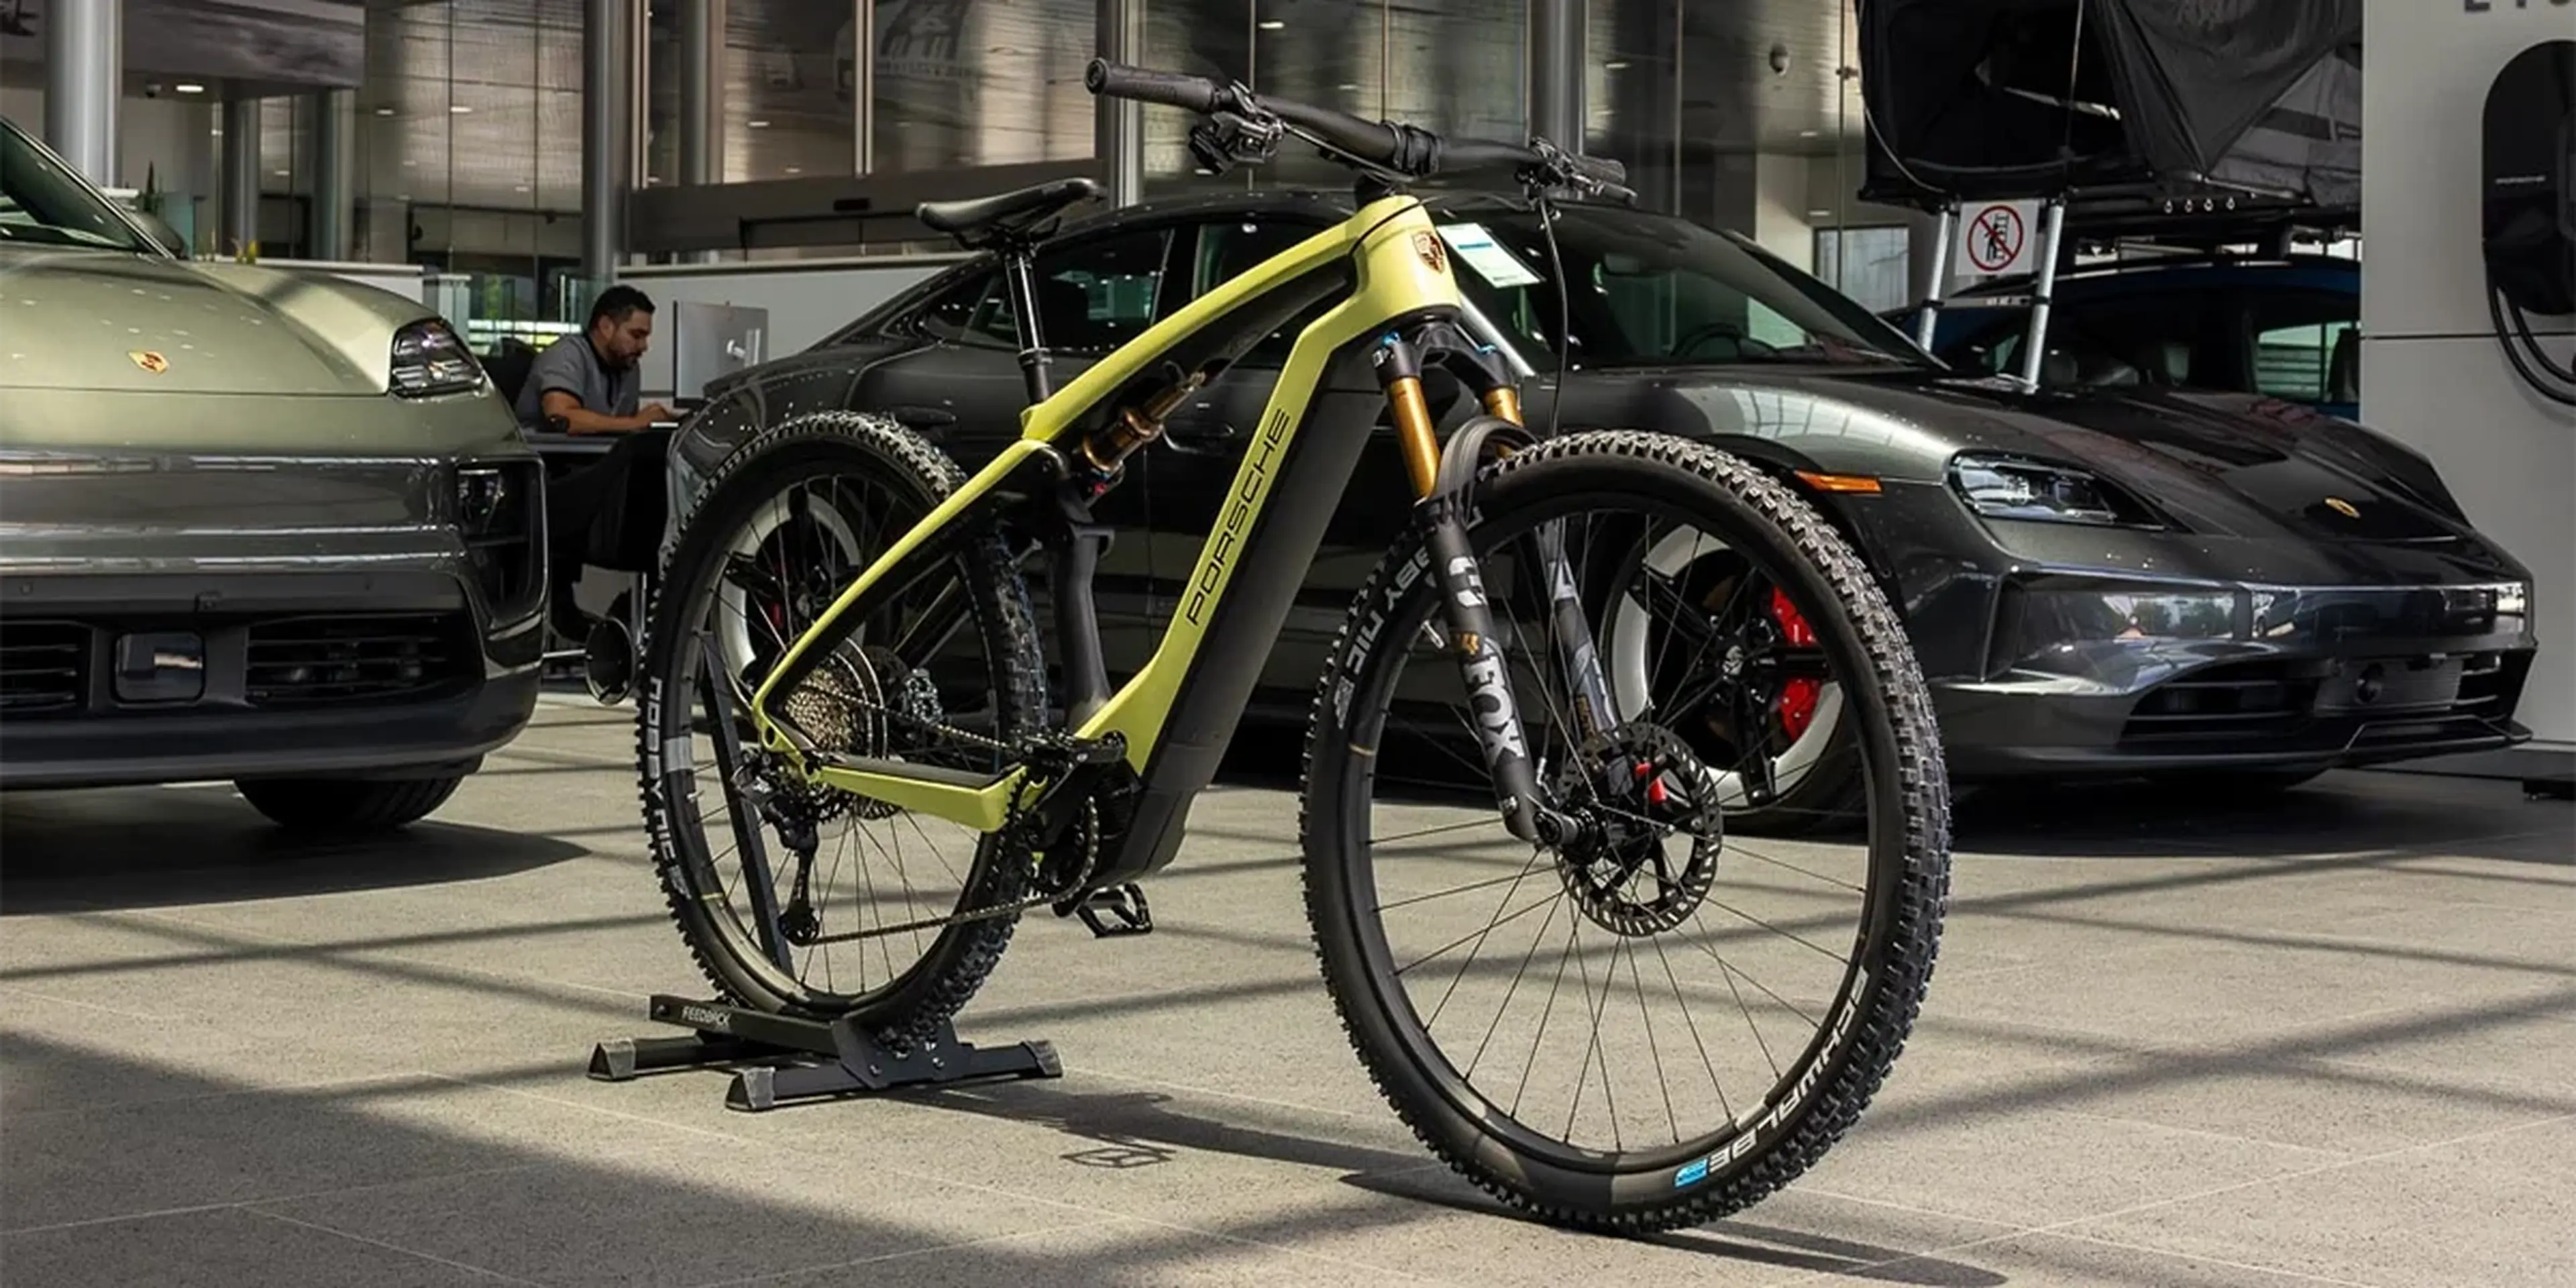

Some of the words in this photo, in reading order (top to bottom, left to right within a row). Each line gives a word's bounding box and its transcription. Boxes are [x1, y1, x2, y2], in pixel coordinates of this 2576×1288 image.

[1186, 408, 1291, 626] PORSCHE
[1345, 610, 1385, 676] NIC
[646, 676, 663, 801] NOBBY
[1462, 655, 1525, 765] FOX
[653, 808, 677, 861] NIC
[682, 1006, 732, 1026] FEEDBACK
[1709, 965, 1870, 1173] SCHWALBE
